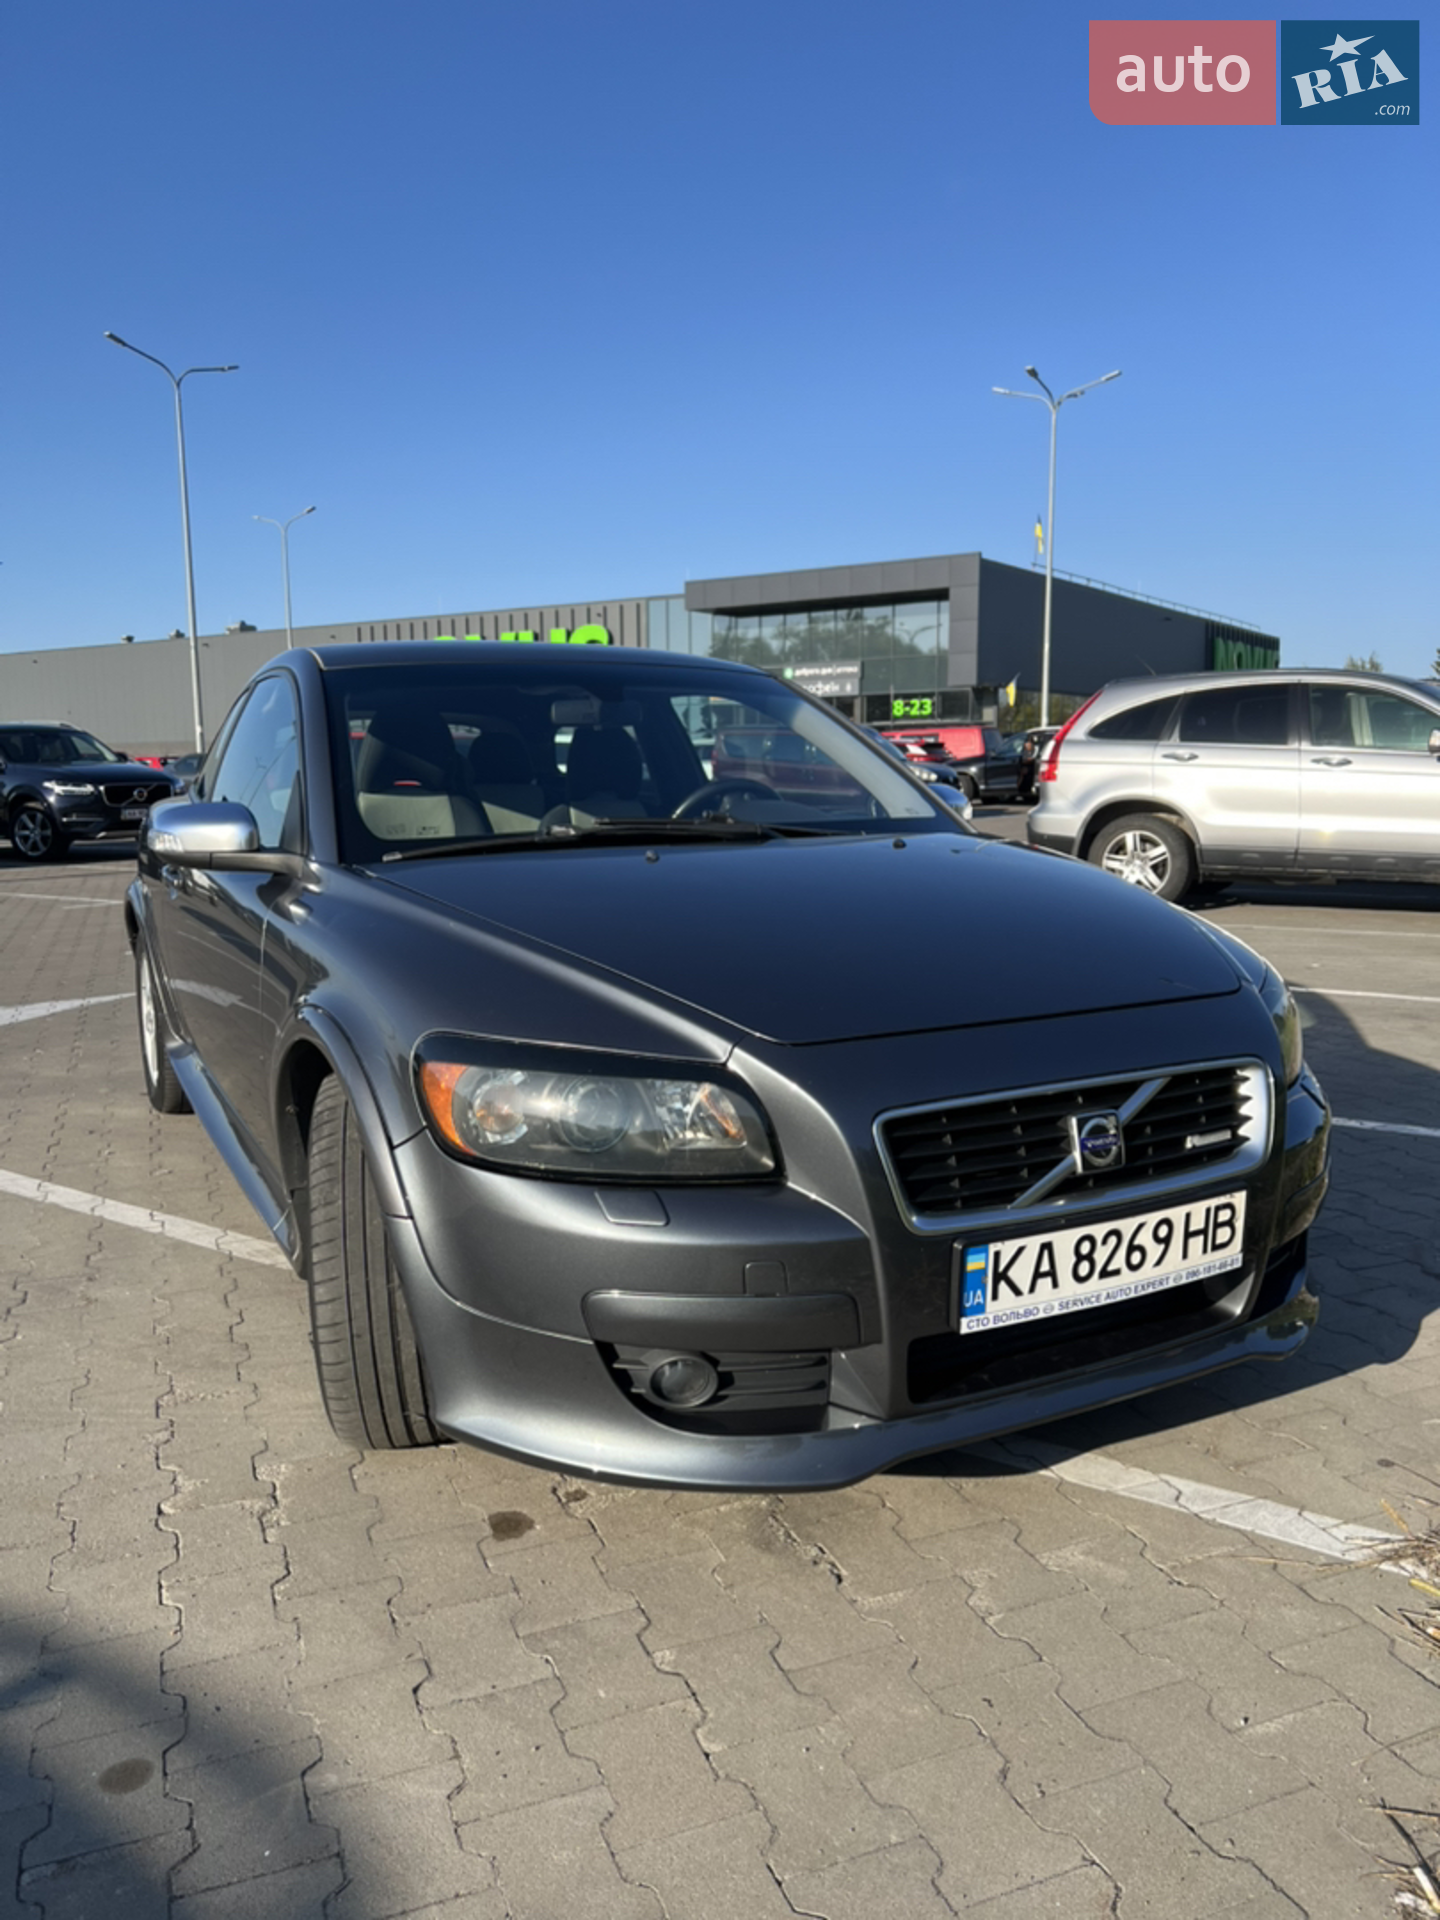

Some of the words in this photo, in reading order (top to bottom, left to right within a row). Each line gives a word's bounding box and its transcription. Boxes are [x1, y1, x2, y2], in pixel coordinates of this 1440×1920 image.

[892, 698, 933, 718] 8-23
[1071, 1216, 1174, 1284] 8269
[963, 1289, 984, 1308] UA
[1057, 1294, 1102, 1311] SERVICE
[1104, 1286, 1132, 1301] AUTO
[1134, 1276, 1171, 1294] EXPERT
